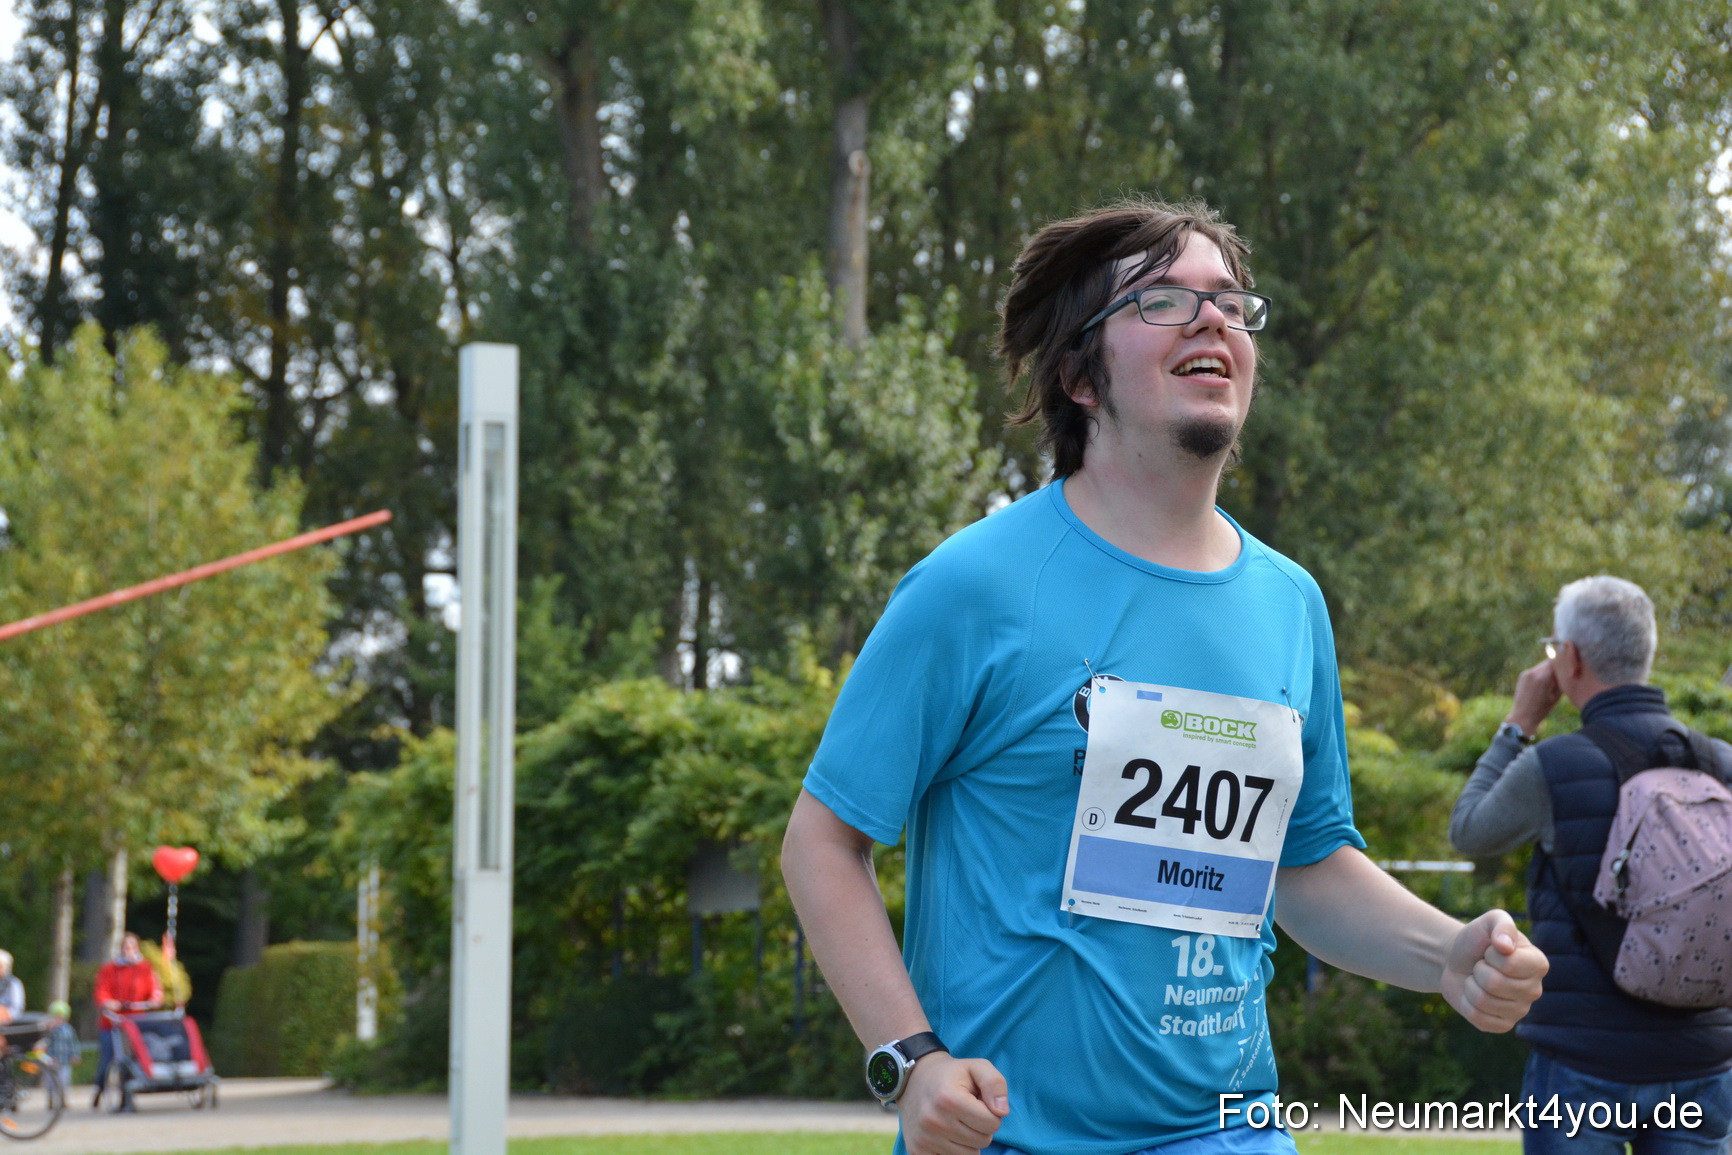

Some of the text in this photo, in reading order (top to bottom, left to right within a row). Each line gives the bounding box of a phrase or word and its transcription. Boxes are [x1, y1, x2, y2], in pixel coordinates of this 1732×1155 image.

[1183, 712, 1257, 741] BOCK
[1183, 732, 1206, 741] inspired
[1233, 740, 1256, 749] concepts
[1114, 758, 1275, 843] 2407
[1089, 813, 1098, 825] D
[1157, 859, 1225, 892] Moritz
[1171, 934, 1224, 978] 18.
[1158, 1000, 1246, 1037] Stadtlauf
